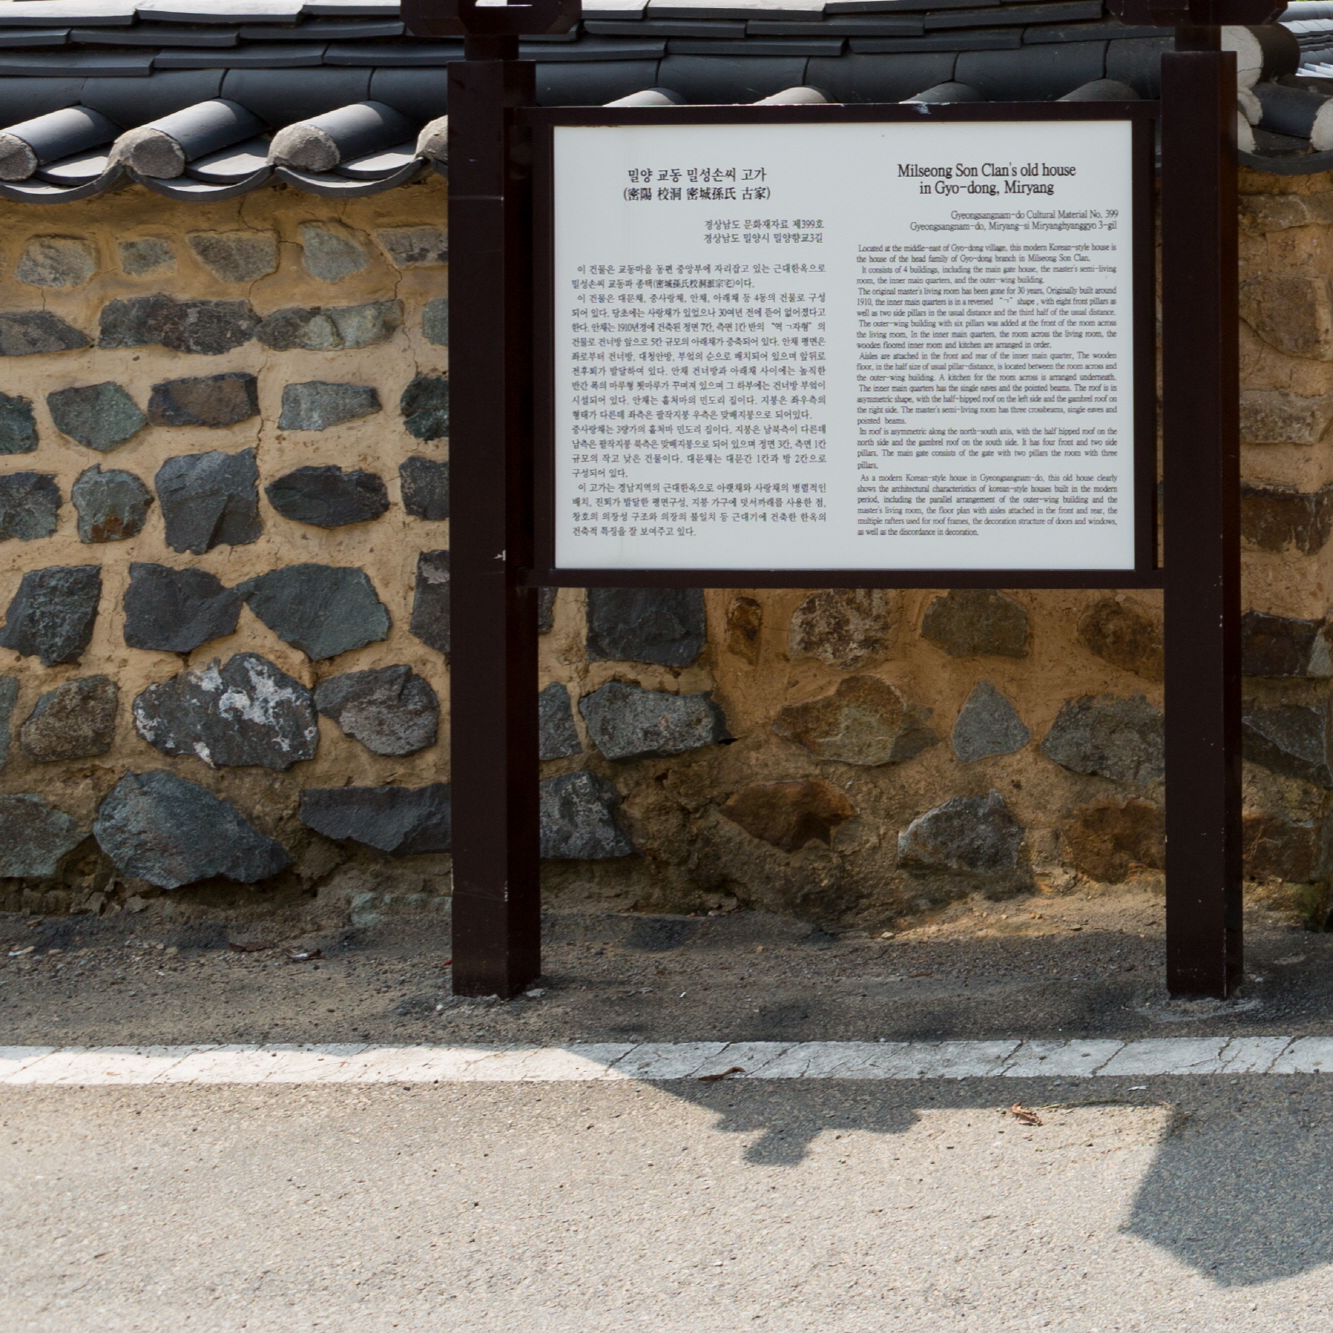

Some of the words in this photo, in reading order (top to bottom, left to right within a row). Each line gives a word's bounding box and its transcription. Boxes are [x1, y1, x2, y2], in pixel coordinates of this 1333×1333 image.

[628, 168, 653, 183] 밀양
[657, 169, 682, 183] 교동
[687, 167, 736, 182] 밀성손씨
[741, 167, 767, 181] 고가
[898, 163, 952, 177] Milseong
[956, 163, 978, 176] Son
[982, 162, 1017, 176] Clan's
[1020, 163, 1038, 176] old
[1042, 163, 1076, 176] house
[623, 187, 652, 201] (密陽
[657, 187, 682, 200] 校洞
[686, 187, 736, 200] 密城孫氏
[742, 187, 770, 200] 古家)
[920, 181, 932, 194] in
[934, 181, 1000, 196] Gyo-dong,
[1004, 180, 1054, 195] Miryang
[951, 210, 1025, 219] Gyeongsangnam-do
[1026, 210, 1056, 219] Cultural
[1058, 210, 1087, 219] Material
[1106, 209, 1118, 219] 399
[704, 219, 741, 230] 경상남도
[744, 219, 790, 229] 문화재자료
[792, 219, 824, 229] 제399호
[910, 222, 986, 232] Gyeongsangnam-do,
[989, 221, 1030, 231] Miryang-si
[1032, 221, 1097, 231] Miryanghyanggyo
[1098, 221, 1117, 231] 3-gil
[704, 233, 740, 244] 경상남도
[743, 233, 770, 243] 밀양시
[773, 233, 823, 243] 밀양향교3길
